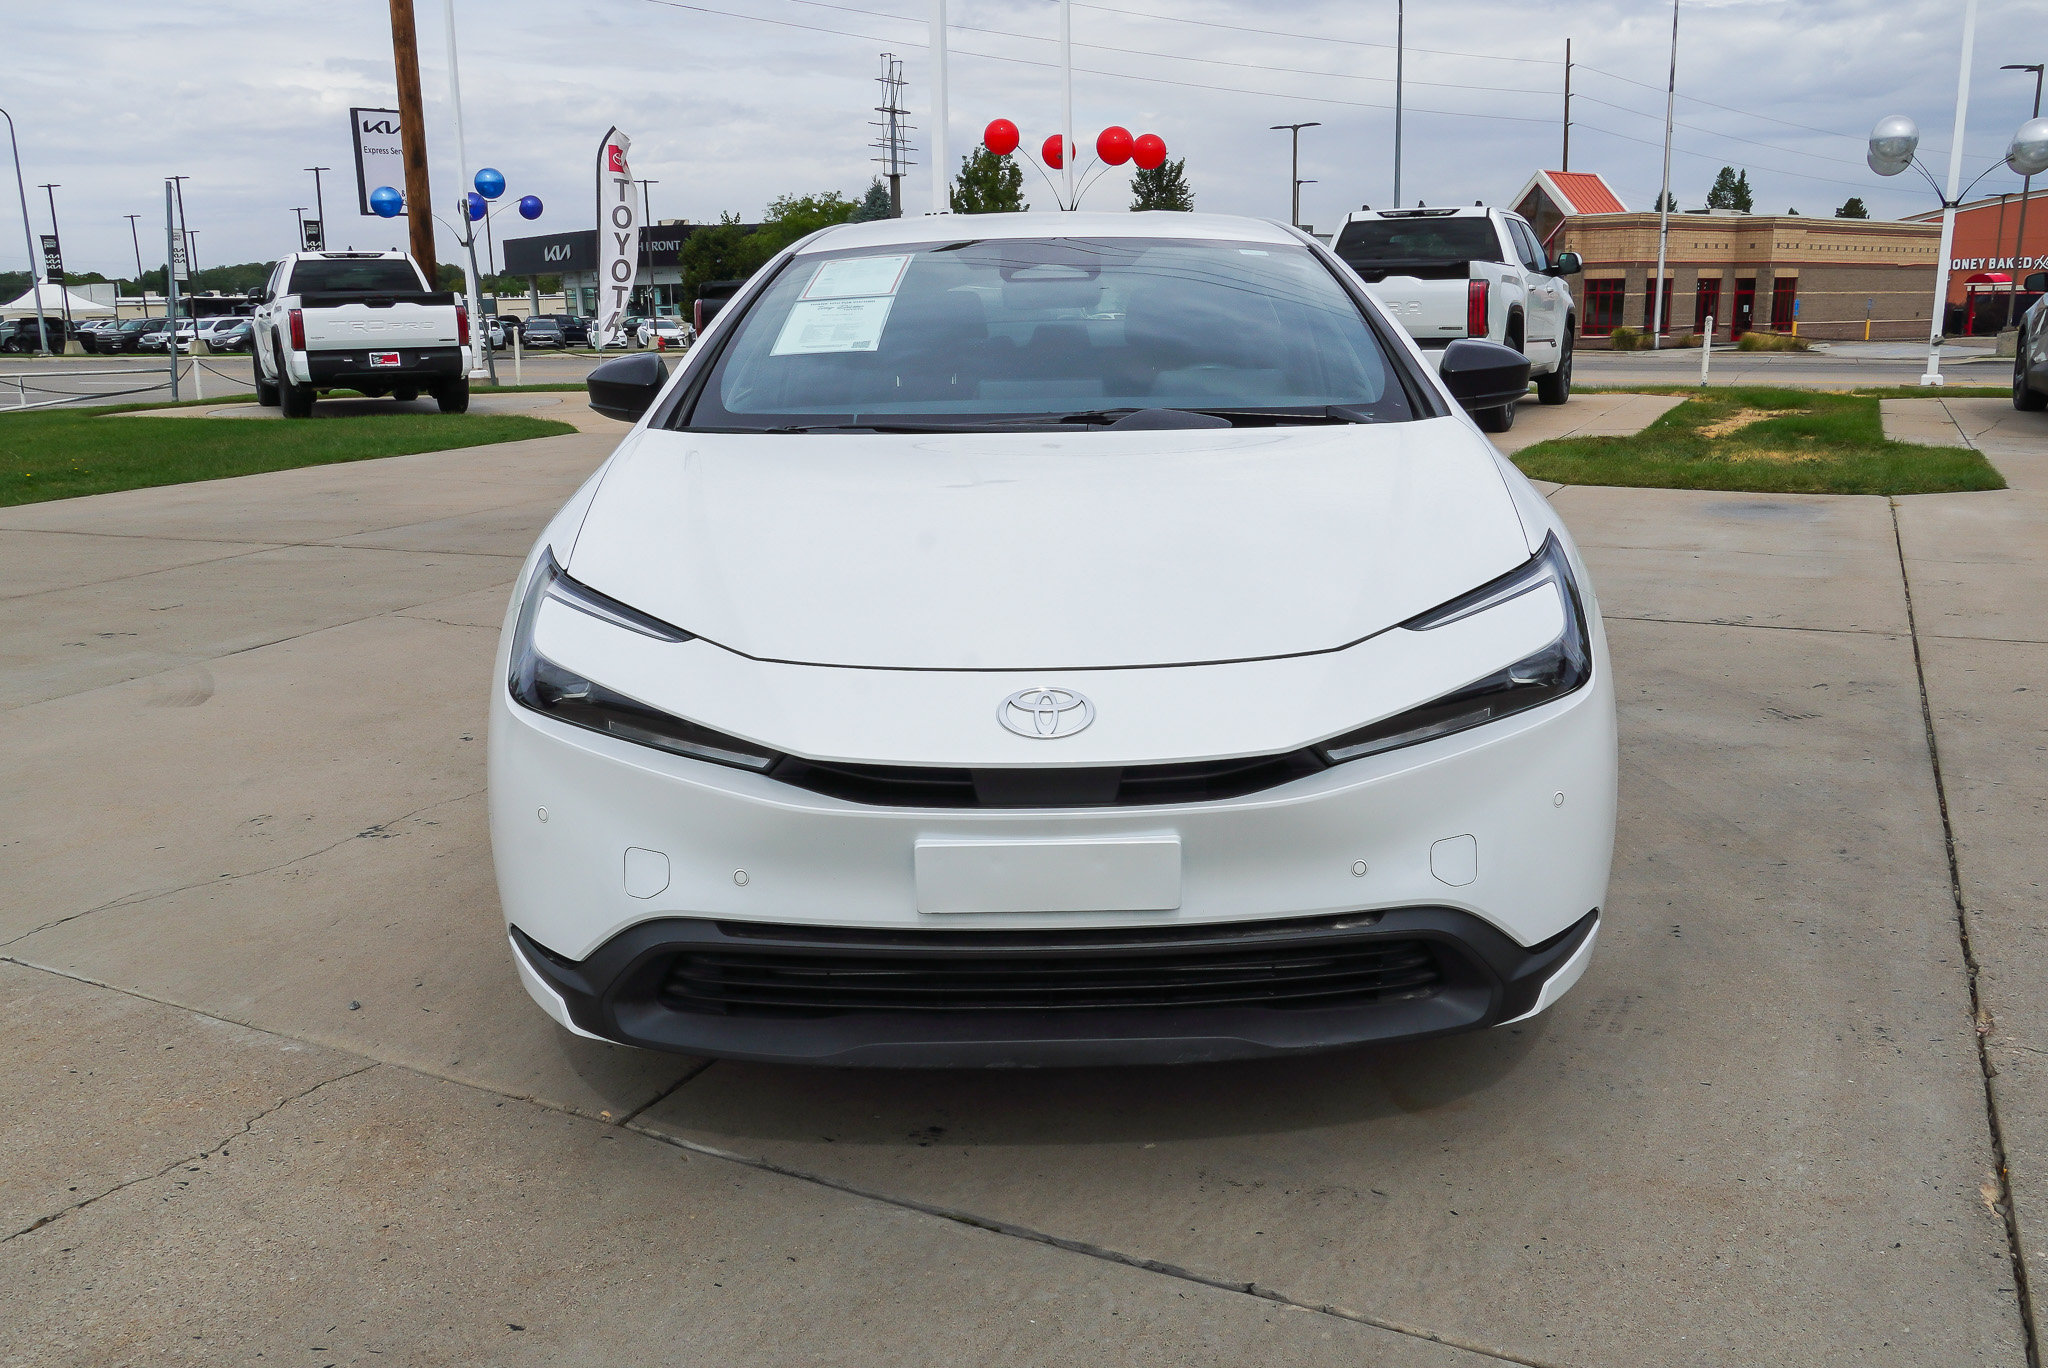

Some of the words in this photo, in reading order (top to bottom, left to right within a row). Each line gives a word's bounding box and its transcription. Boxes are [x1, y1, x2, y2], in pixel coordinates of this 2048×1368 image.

[363, 146, 389, 155] Express
[544, 244, 571, 262] KIA
[604, 178, 632, 338] TOYOTA
[1950, 257, 1986, 270] ONEY
